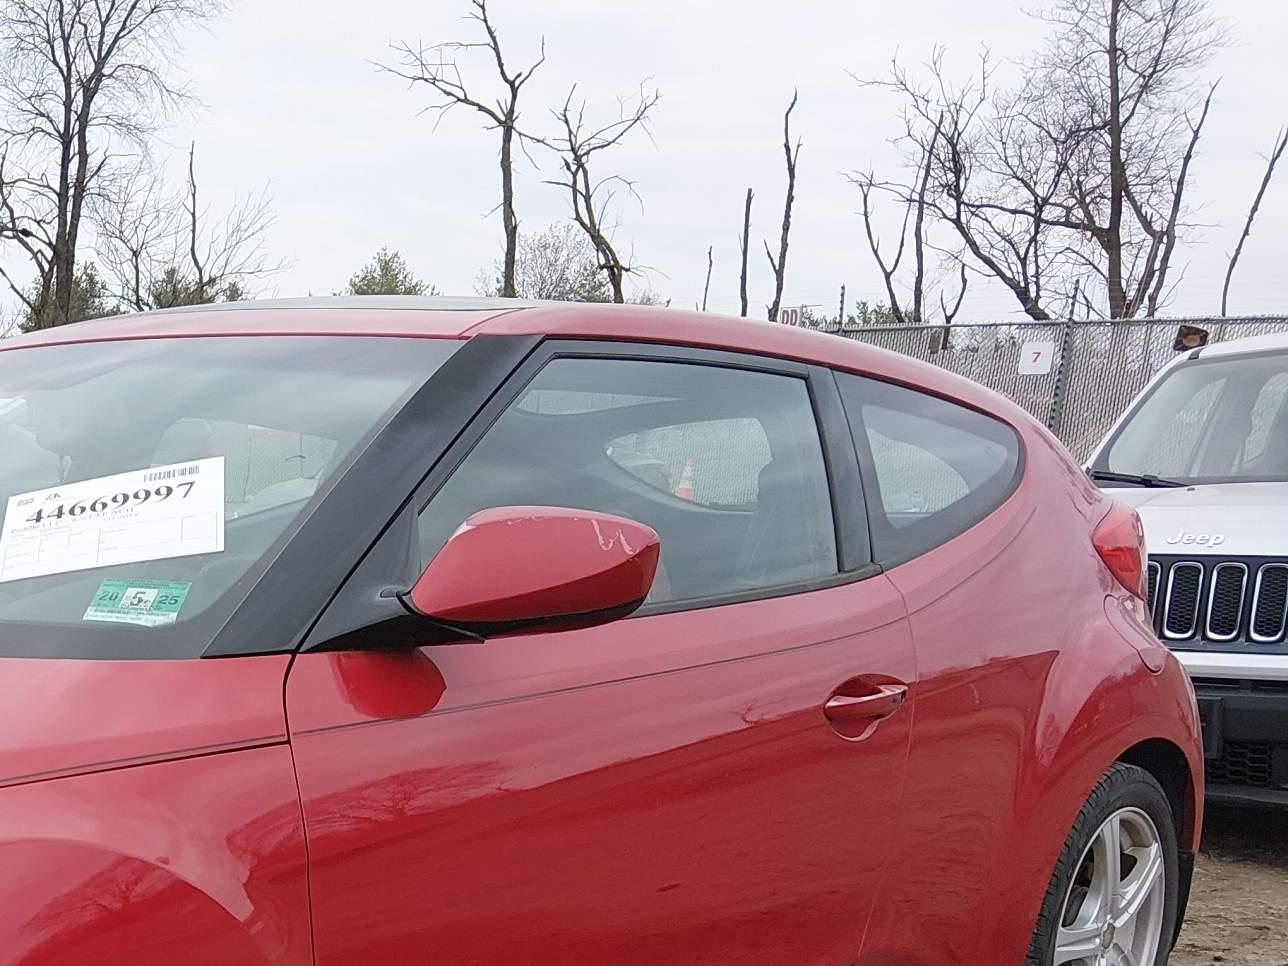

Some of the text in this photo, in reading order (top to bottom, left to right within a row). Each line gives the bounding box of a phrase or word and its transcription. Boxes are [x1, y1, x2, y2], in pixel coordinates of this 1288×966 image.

[1032, 351, 1042, 363] 7
[25, 481, 196, 524] 44669997
[1166, 531, 1226, 548] Jeep
[98, 590, 181, 607] 20 5 25
